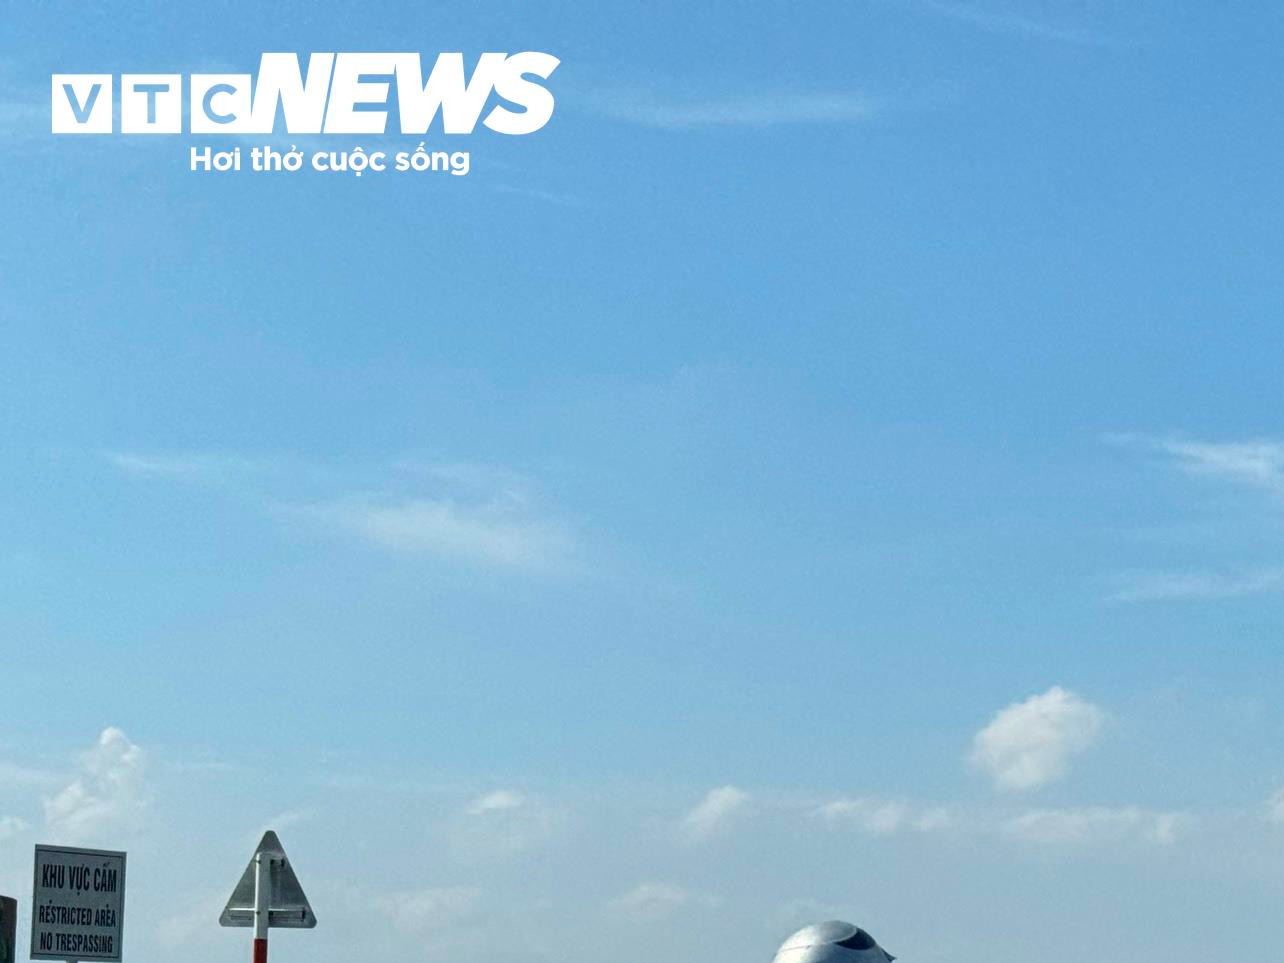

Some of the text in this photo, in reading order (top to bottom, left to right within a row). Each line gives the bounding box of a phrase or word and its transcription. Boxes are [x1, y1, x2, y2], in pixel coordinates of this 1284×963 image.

[42, 862, 117, 896] KHU VỰC CẤM
[39, 905, 116, 927] RESTRICTED AREA
[40, 932, 112, 953] NO TRESPASSING
